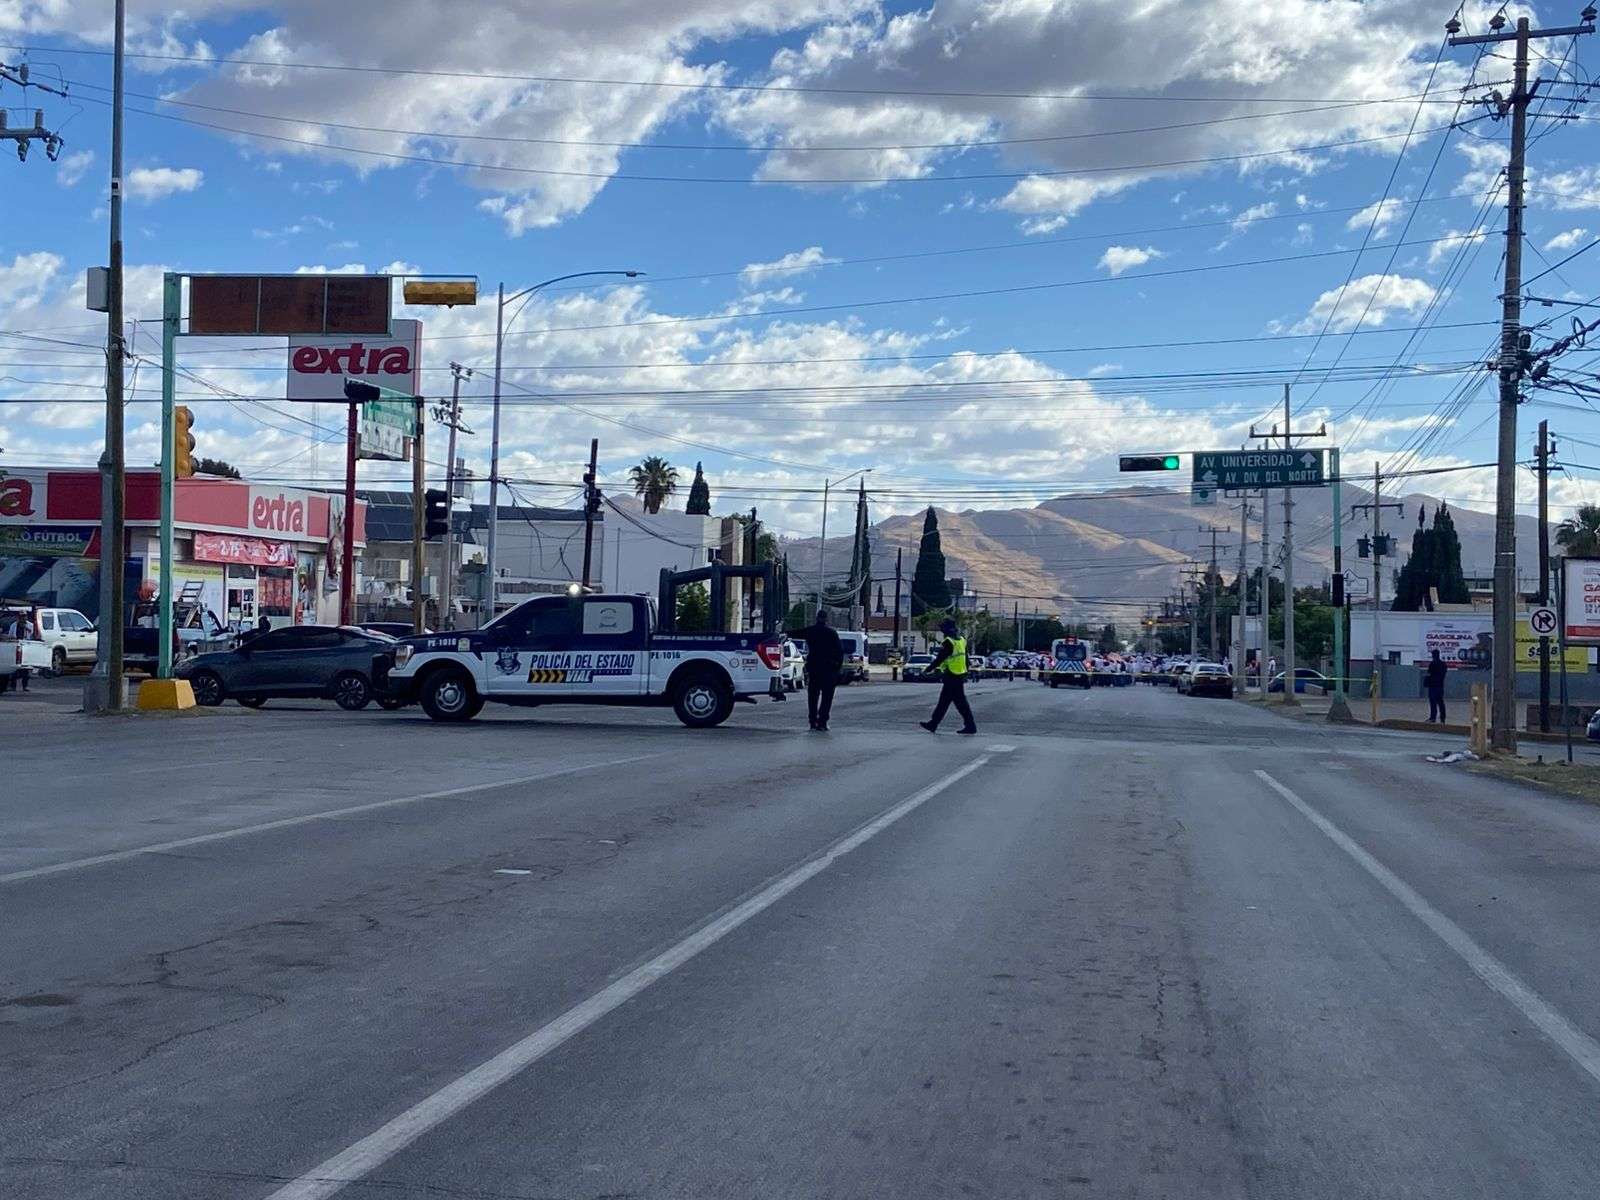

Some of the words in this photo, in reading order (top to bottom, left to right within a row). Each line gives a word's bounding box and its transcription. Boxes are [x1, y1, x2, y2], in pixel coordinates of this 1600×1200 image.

[292, 343, 412, 375] extra
[1222, 454, 1293, 468] UNIVERSIDAD
[1265, 471, 1281, 482] DEL
[1289, 470, 1317, 481] NORTE
[253, 494, 304, 532] extra
[34, 530, 82, 542] FÚTBOL
[531, 653, 571, 669] POLICÍA
[575, 654, 593, 669] DEL
[596, 654, 634, 669] ESTADO
